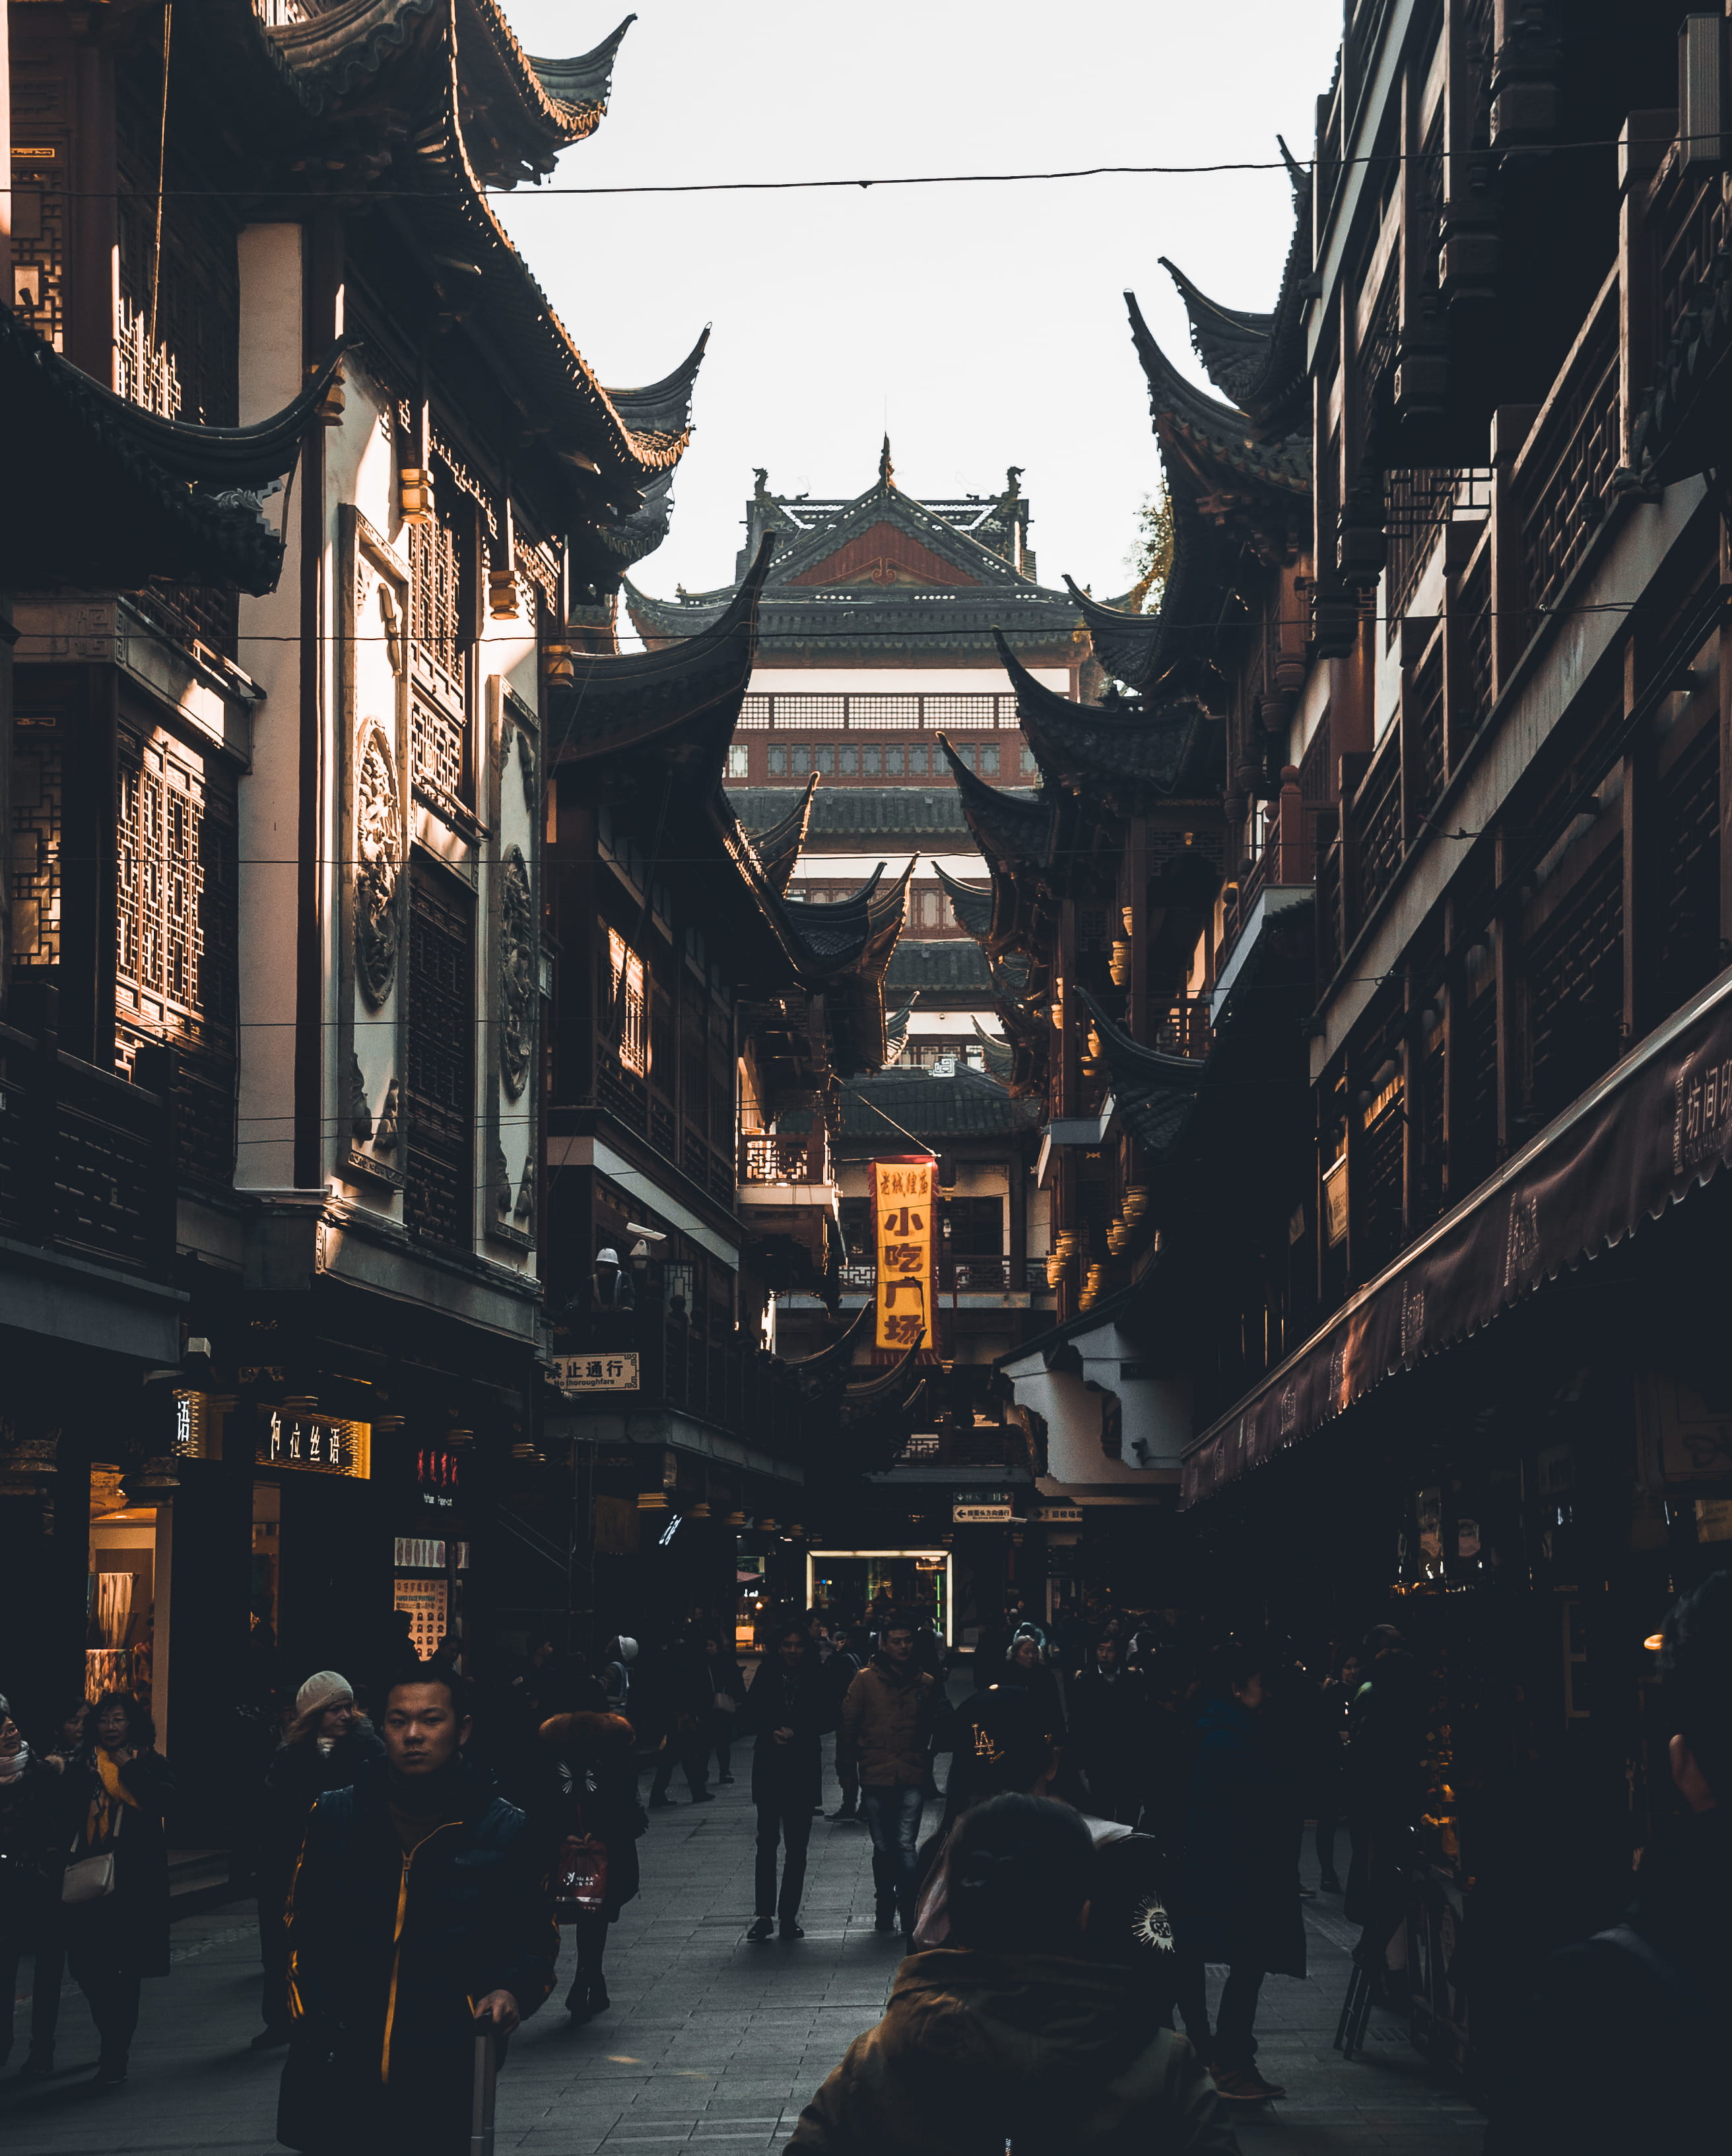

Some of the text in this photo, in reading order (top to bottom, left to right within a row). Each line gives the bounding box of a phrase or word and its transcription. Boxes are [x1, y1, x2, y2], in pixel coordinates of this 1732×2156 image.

[884, 1207, 926, 1344] 小吃广场
[547, 1360, 623, 1379] 禁止通行
[176, 1400, 190, 1442] 语
[271, 1410, 340, 1464] 阿拉丝语
[972, 1723, 995, 1755] LA
